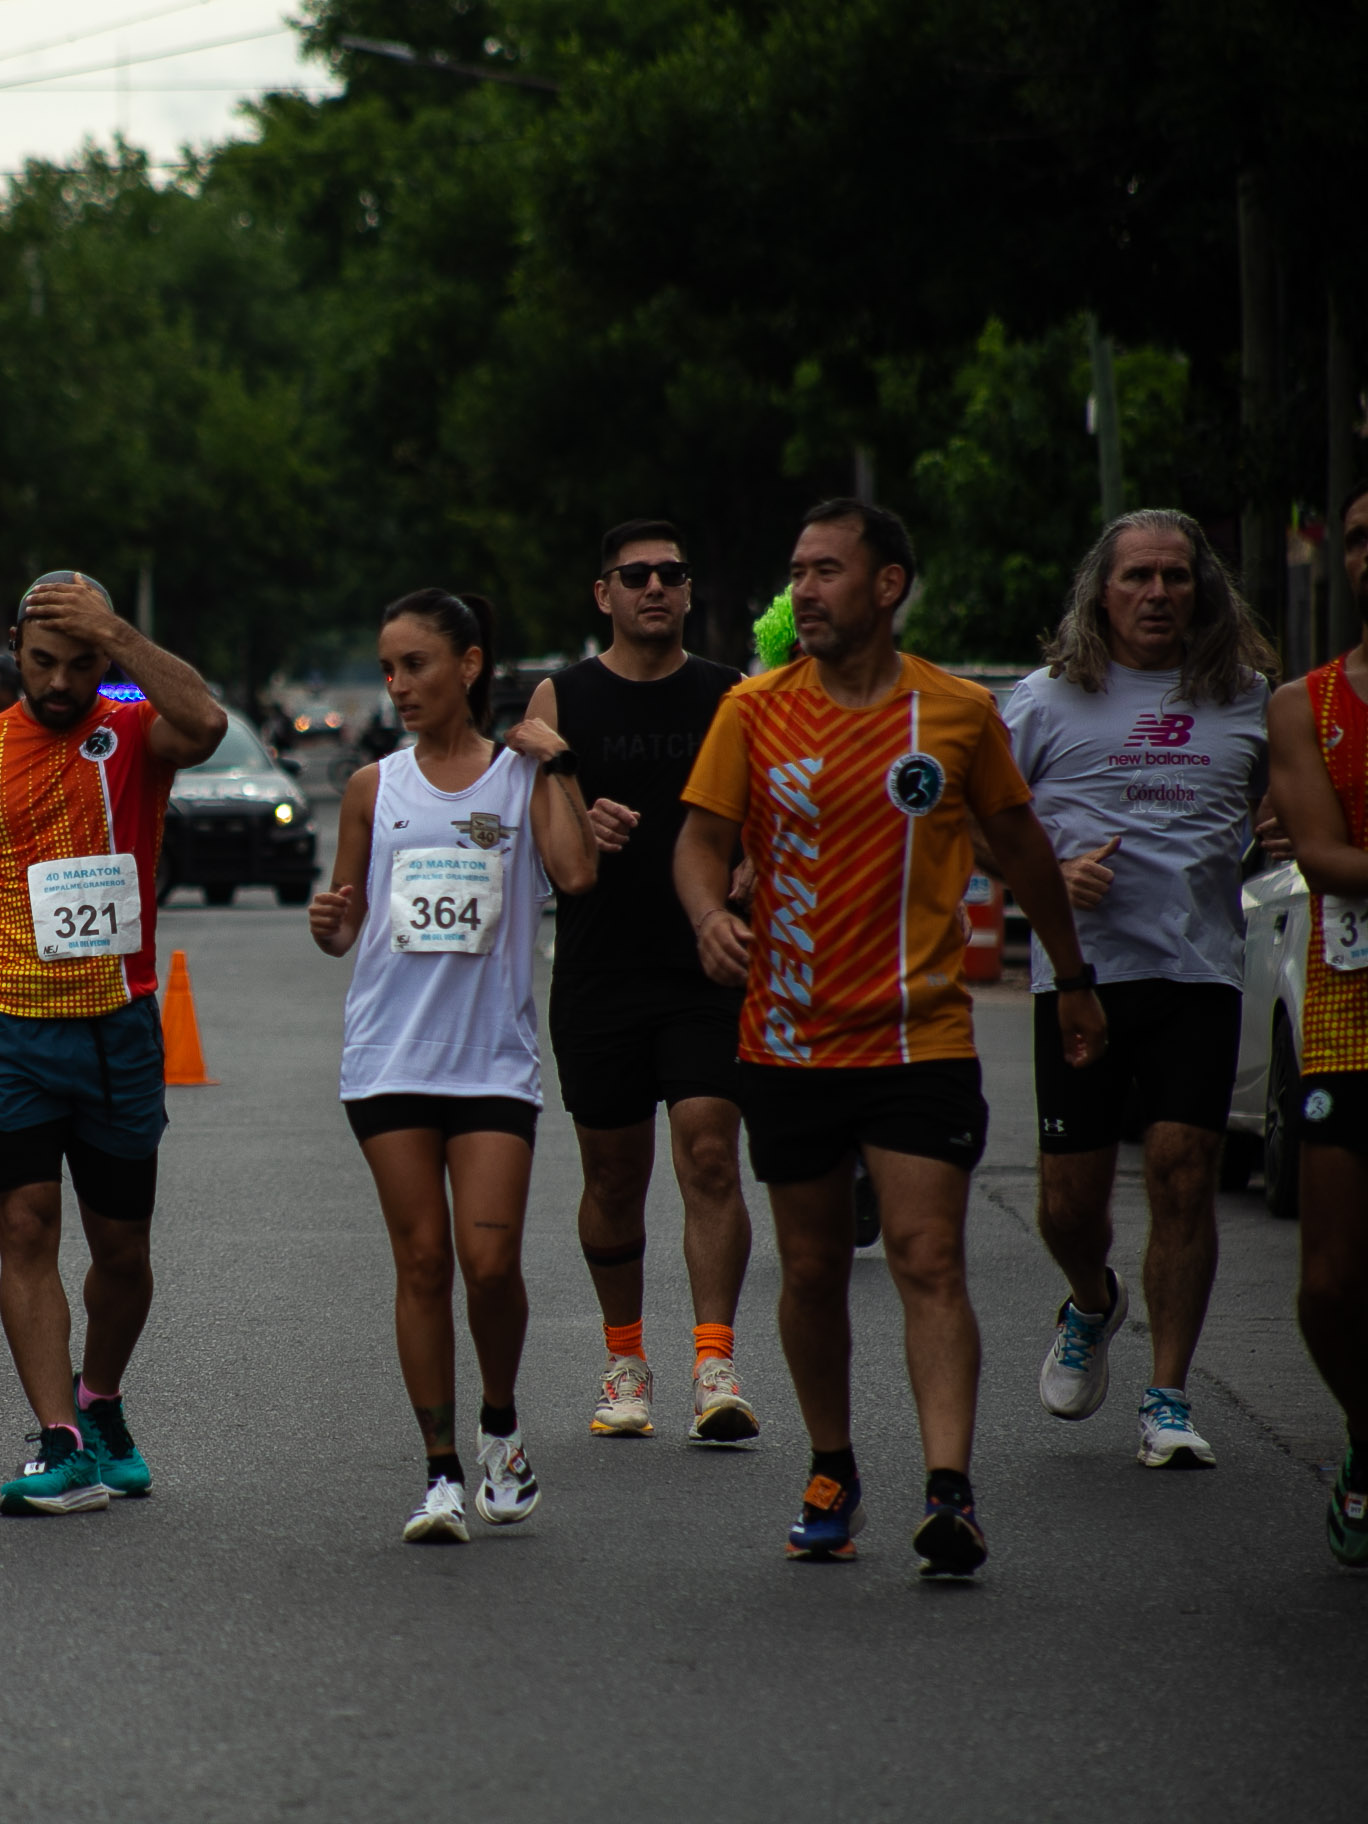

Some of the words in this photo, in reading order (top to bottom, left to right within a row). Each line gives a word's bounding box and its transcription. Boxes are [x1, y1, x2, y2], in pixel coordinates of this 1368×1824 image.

[602, 731, 703, 762] MATCH
[1108, 753, 1141, 766] new
[1145, 752, 1211, 766] balance
[1126, 783, 1195, 801] Córdoba
[477, 831, 495, 842] 40
[409, 860, 423, 869] 40
[426, 860, 487, 870] MARATON
[46, 873, 60, 881] 40
[63, 867, 121, 880] MARATON
[44, 883, 81, 893] EMPALME
[83, 879, 126, 889] GRANEROS
[53, 902, 118, 939] 321
[410, 896, 481, 931] 364
[43, 945, 59, 954] NEJ
